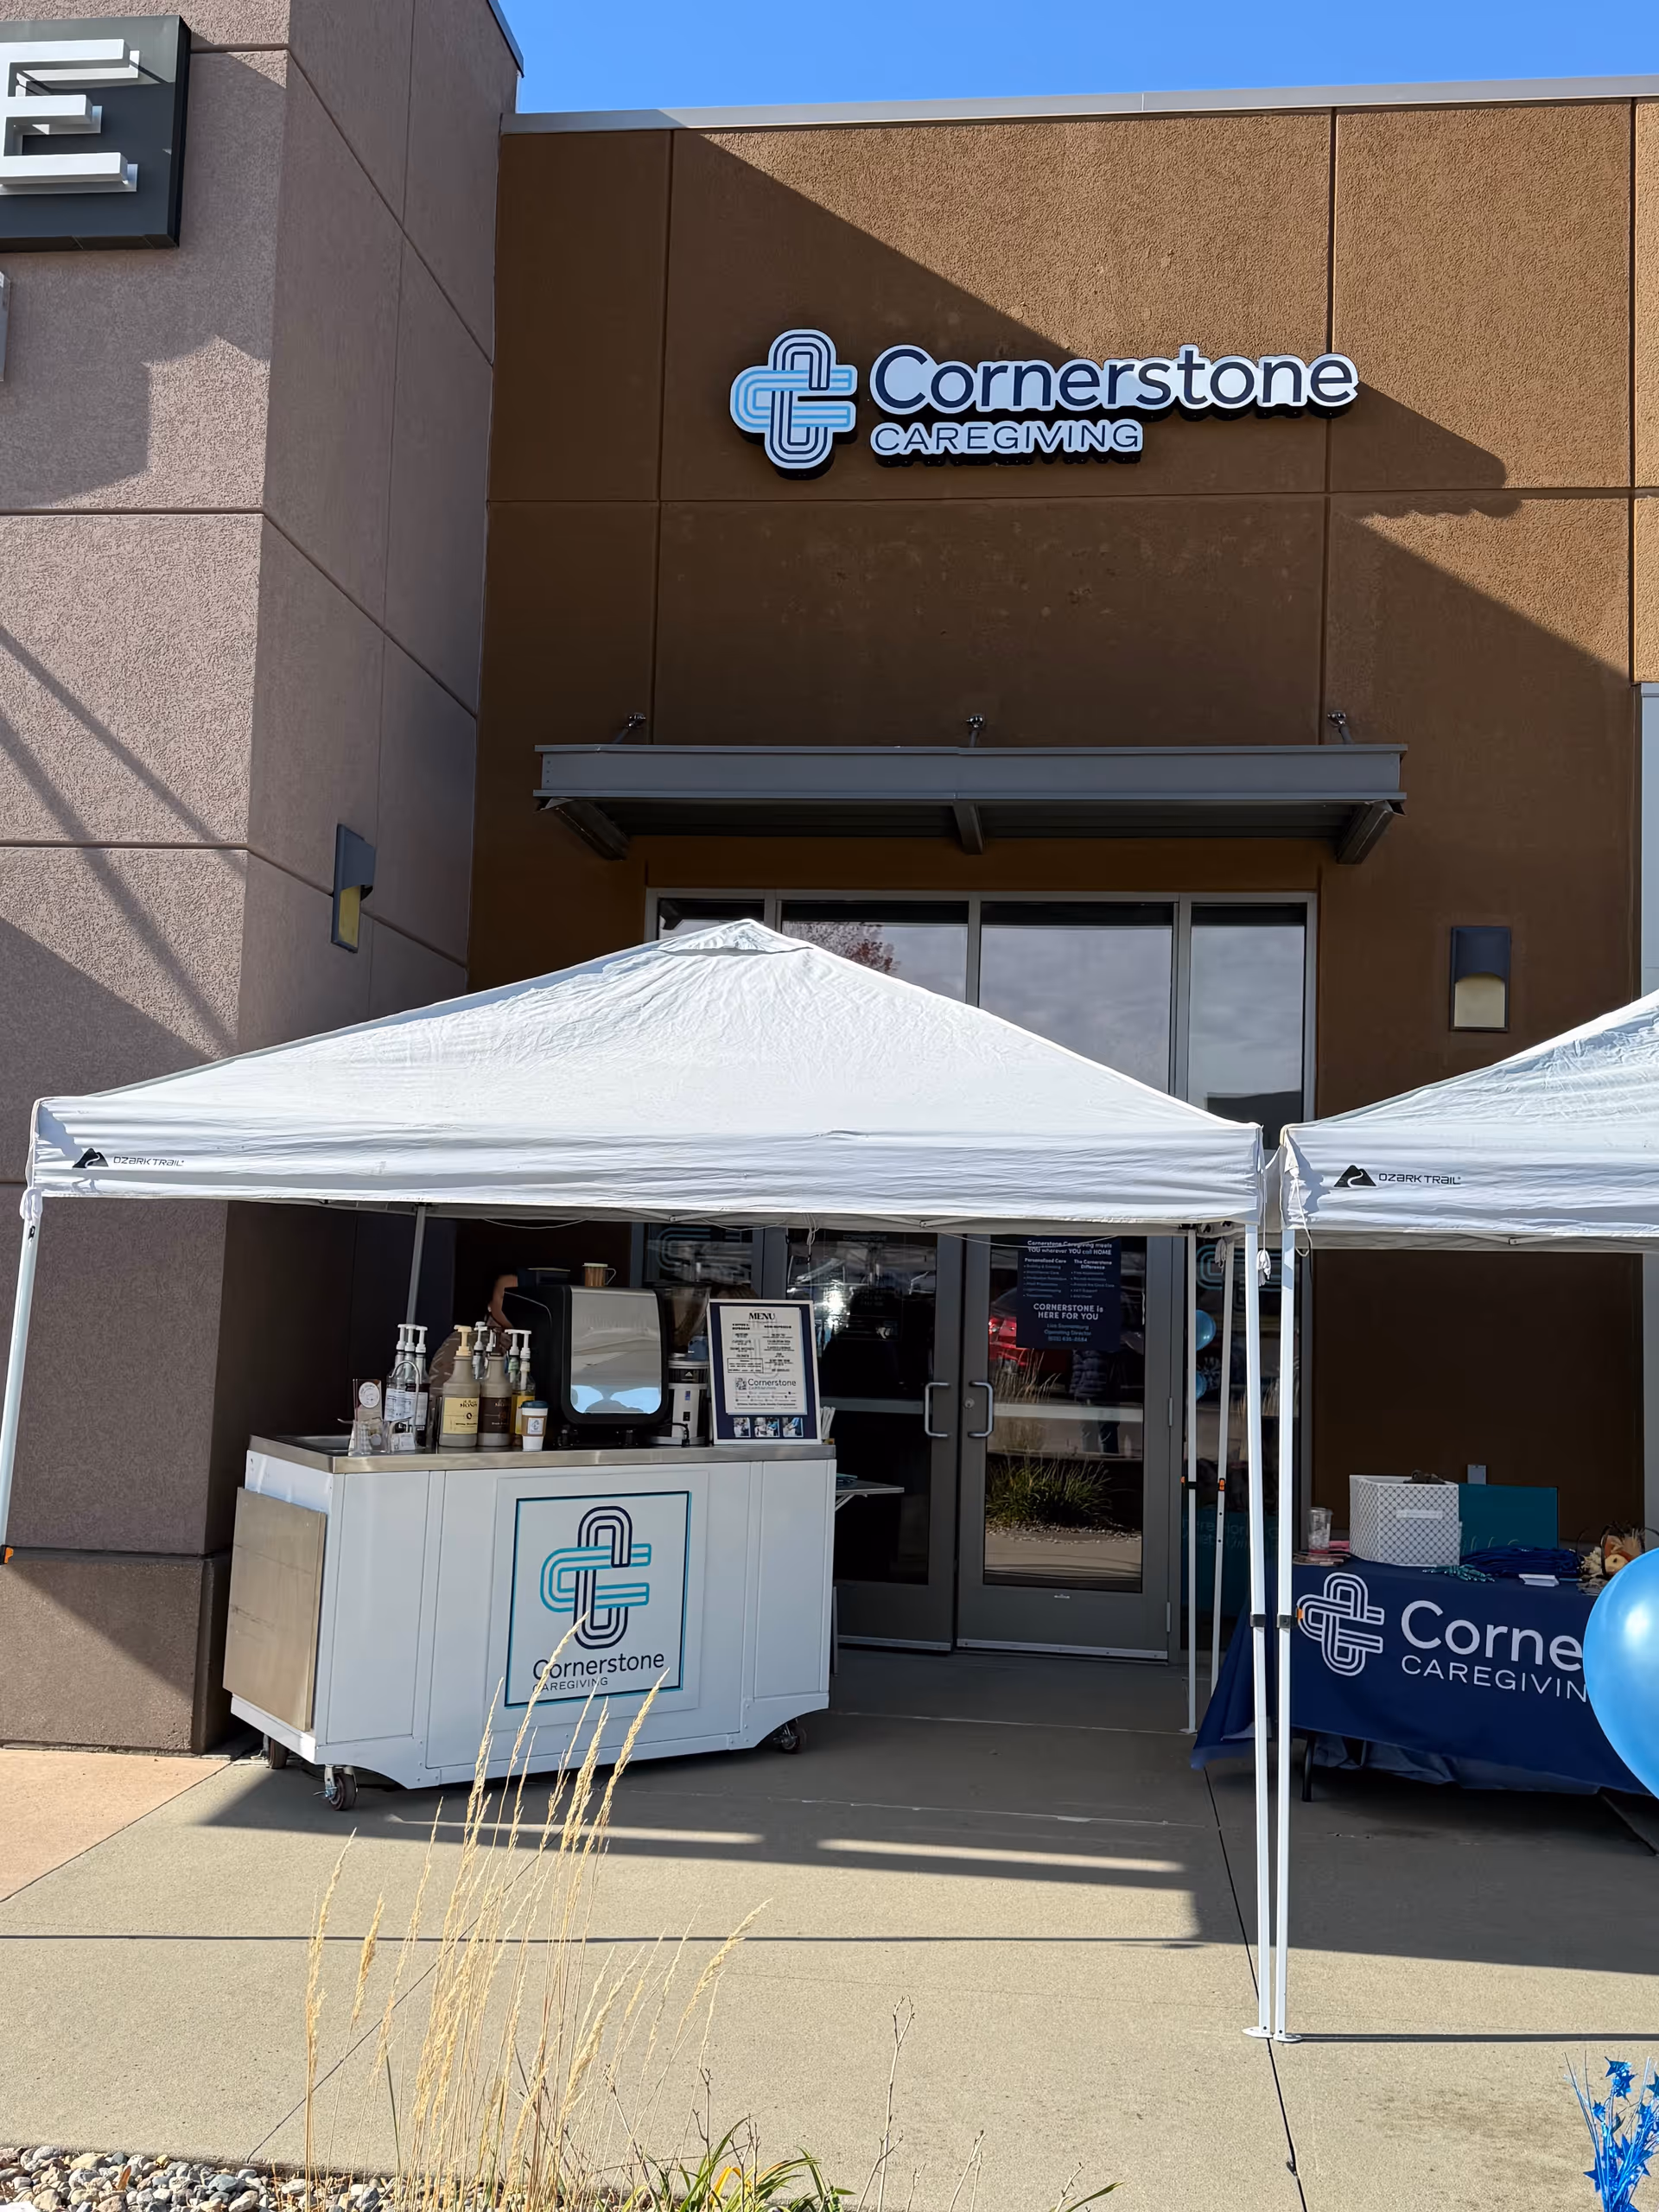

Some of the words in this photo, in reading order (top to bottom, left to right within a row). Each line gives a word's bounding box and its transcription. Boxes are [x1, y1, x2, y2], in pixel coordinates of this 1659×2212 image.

[874, 344, 1353, 410] Cornerstone
[874, 423, 1140, 453] CAREGIVING
[1033, 1303, 1095, 1313] CORNERSTONE
[1401, 1599, 1584, 1671] Corne
[533, 1652, 664, 1681] Cornerstone
[1401, 1655, 1587, 1702] CAREGIVIN
[532, 1676, 608, 1692] CAREGIVING
